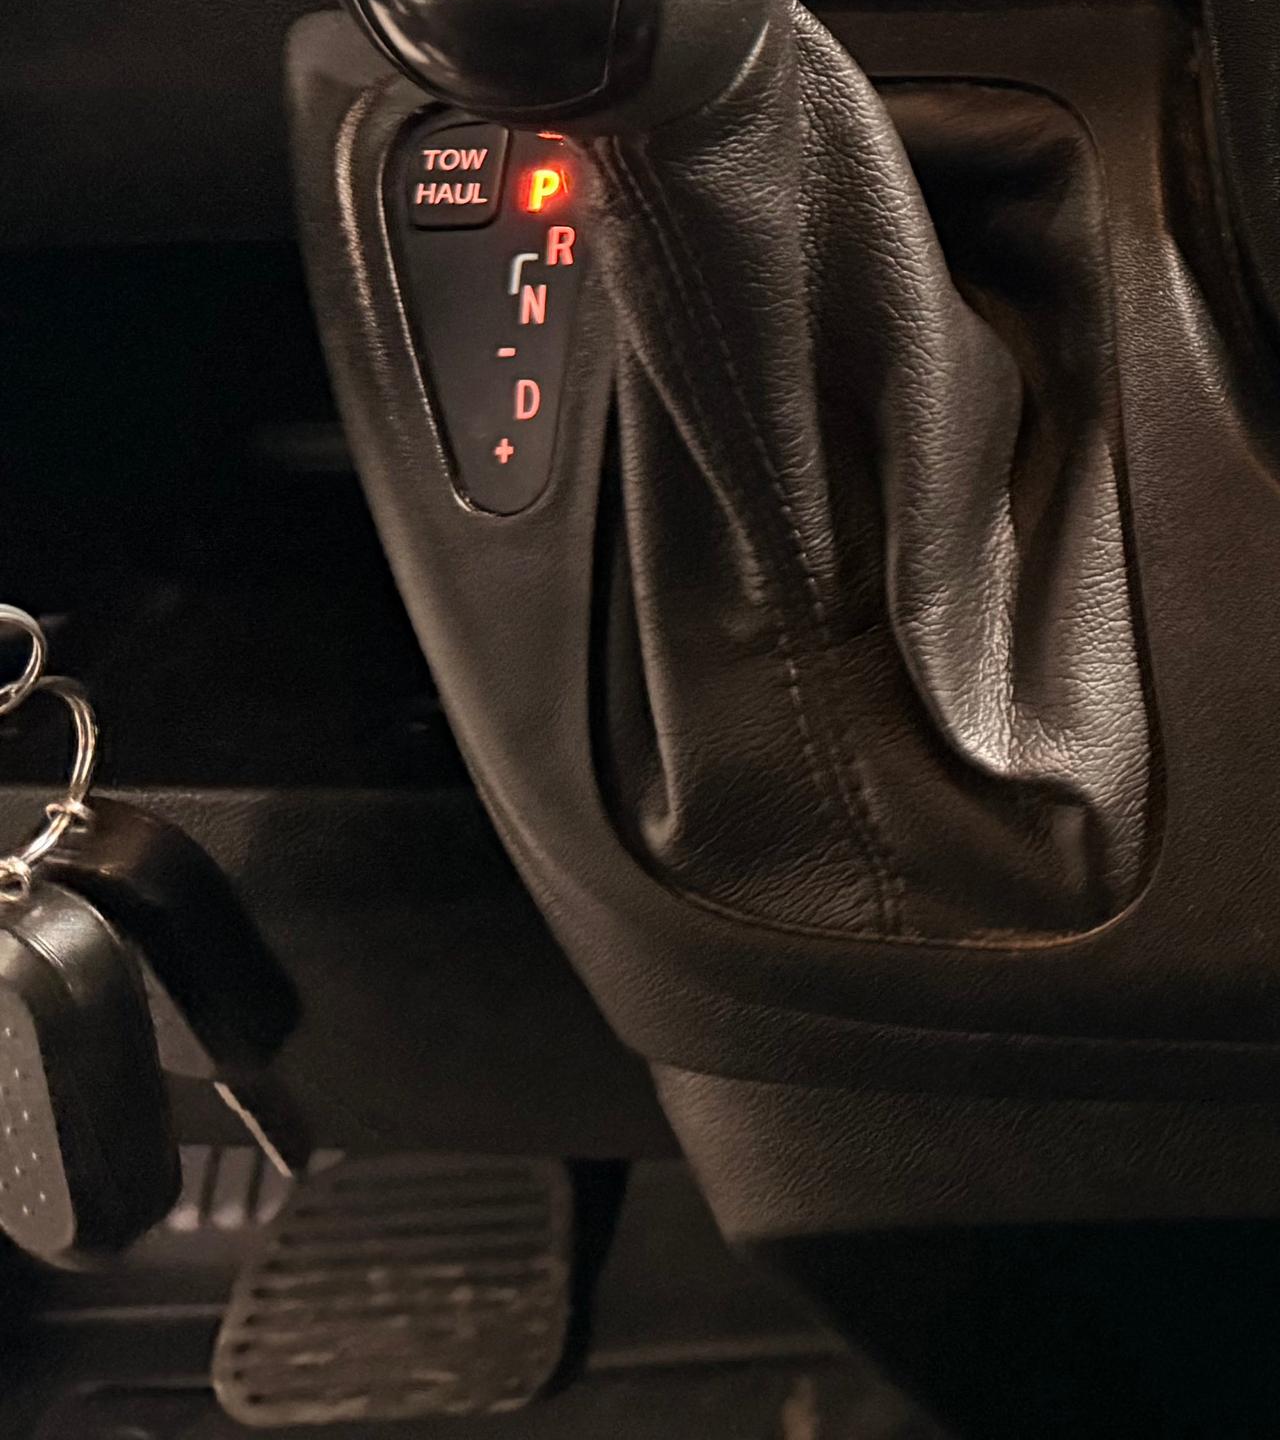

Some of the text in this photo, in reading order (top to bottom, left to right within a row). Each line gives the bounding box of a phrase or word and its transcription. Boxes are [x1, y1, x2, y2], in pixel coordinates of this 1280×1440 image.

[422, 148, 489, 172] TOW
[415, 182, 489, 206] HAUL
[527, 169, 561, 214] P
[546, 225, 577, 267] R
[519, 284, 549, 325] N
[514, 378, 542, 421] D
